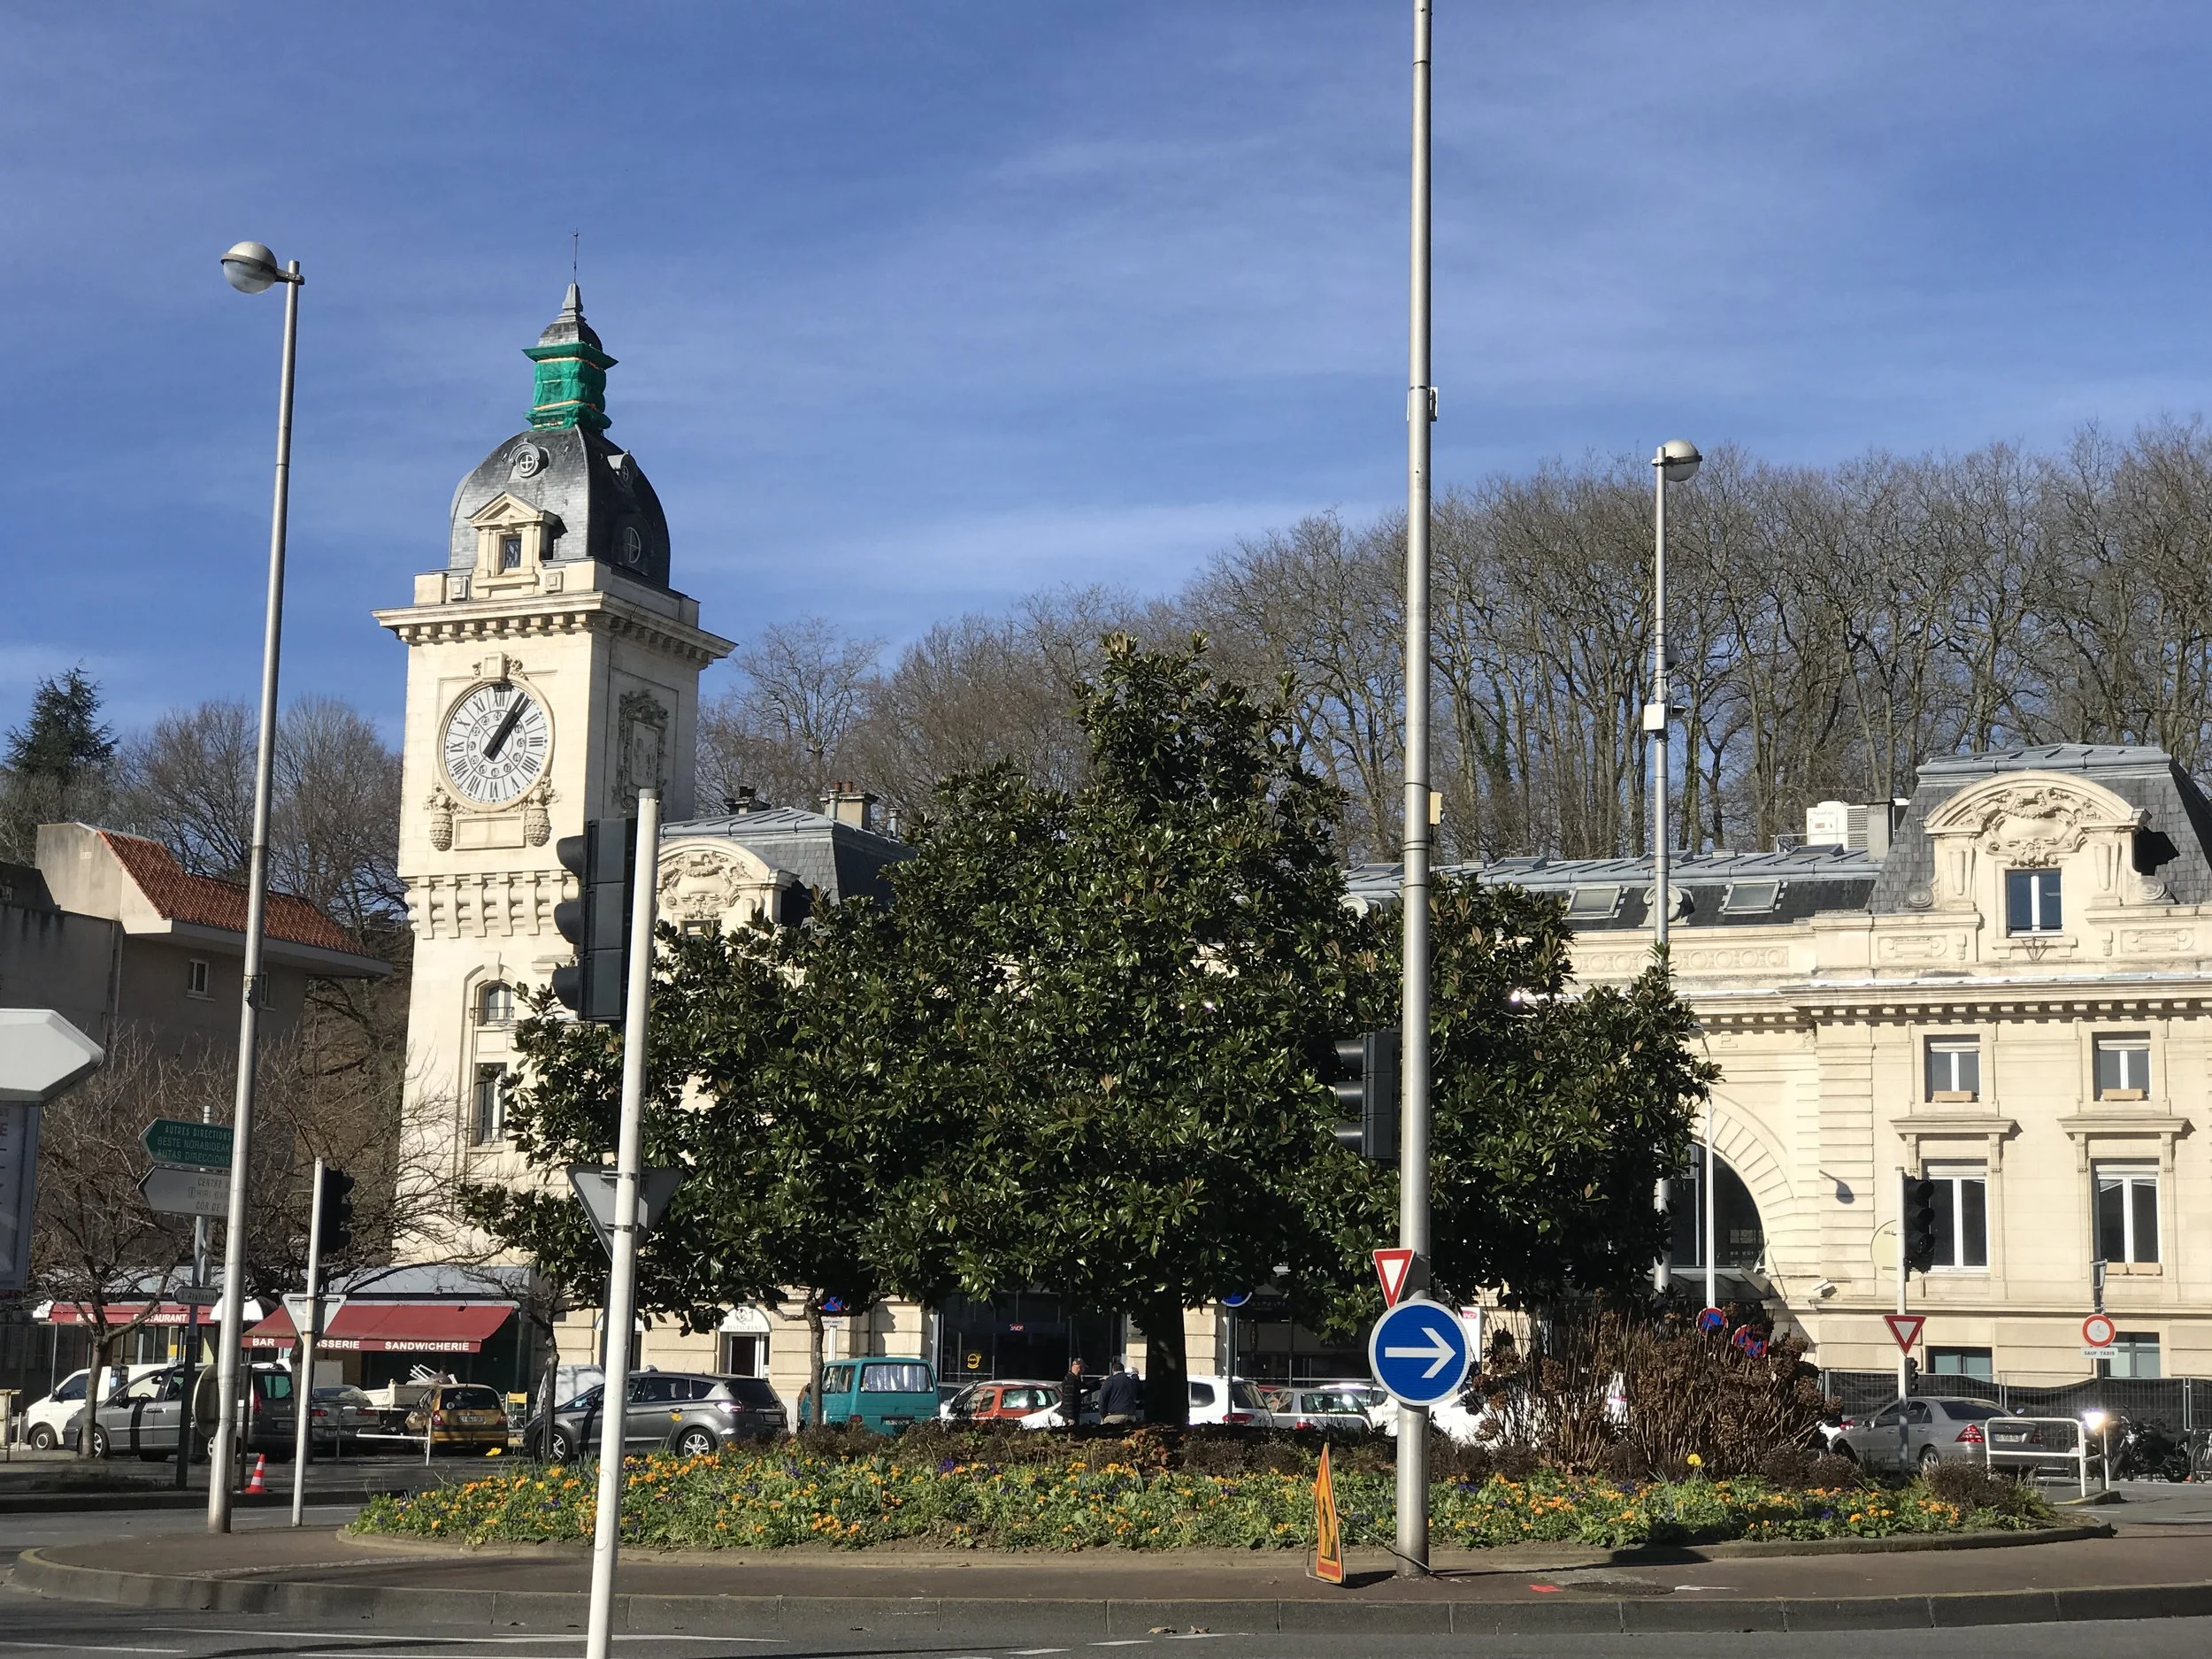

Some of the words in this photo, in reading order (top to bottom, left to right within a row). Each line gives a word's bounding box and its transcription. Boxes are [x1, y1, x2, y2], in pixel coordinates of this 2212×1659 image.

[165, 1125, 190, 1136] AUTRES
[193, 1128, 232, 1141] DIRECTIONS
[157, 1136, 181, 1148] BESTE
[157, 1148, 181, 1160] AUTAS
[197, 1177, 222, 1188] CENTRE
[76, 1313, 94, 1322] BR
[252, 1338, 275, 1347] BAR
[315, 1339, 360, 1349] ASSERIE
[384, 1340, 470, 1351] SANDWICHERIE
